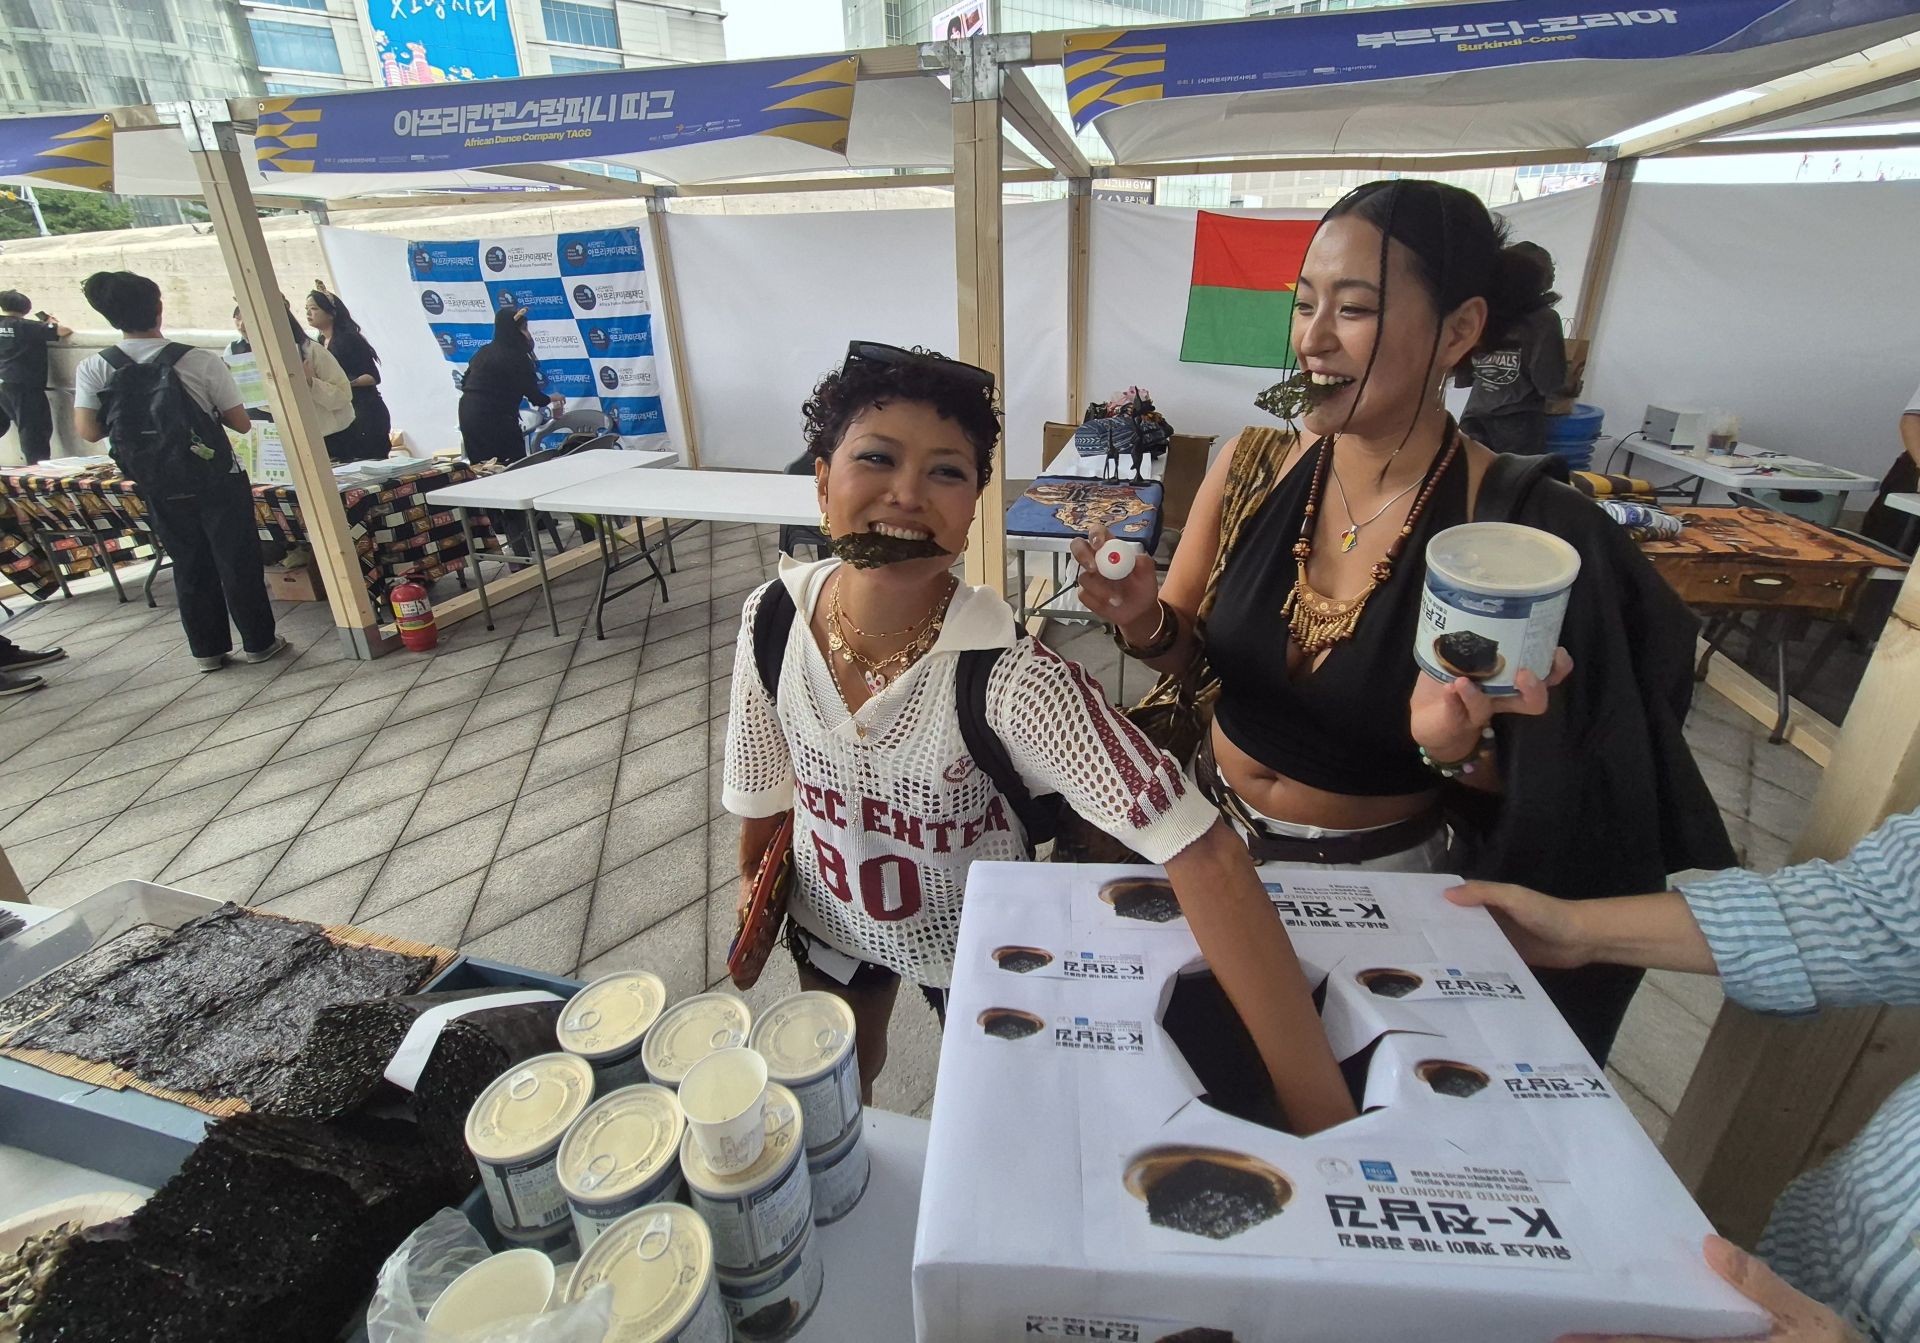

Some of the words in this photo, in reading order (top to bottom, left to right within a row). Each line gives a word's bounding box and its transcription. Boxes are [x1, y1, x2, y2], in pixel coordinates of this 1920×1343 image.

[1356, 8, 1679, 49] 부르킨디-코리아
[393, 94, 617, 137] 아프리칸댄스컴퍼니
[620, 90, 675, 121] 따그
[464, 136, 495, 148] African
[495, 134, 522, 145] Dance
[522, 131, 565, 144] Company
[566, 128, 592, 139] TAGG
[507, 253, 552, 262] 아프리카미래재단
[1055, 1028, 1144, 1045] K-전남김
[1367, 1184, 1397, 1194] GIM
[1401, 1186, 1471, 1200] SEASONED
[1478, 1191, 1541, 1204] ROASTED
[1325, 1194, 1564, 1239] K-전남김
[1408, 1237, 1444, 1252] 키운
[1446, 1240, 1500, 1256] 갯벌이
[1500, 1243, 1571, 1260] 유네스코
